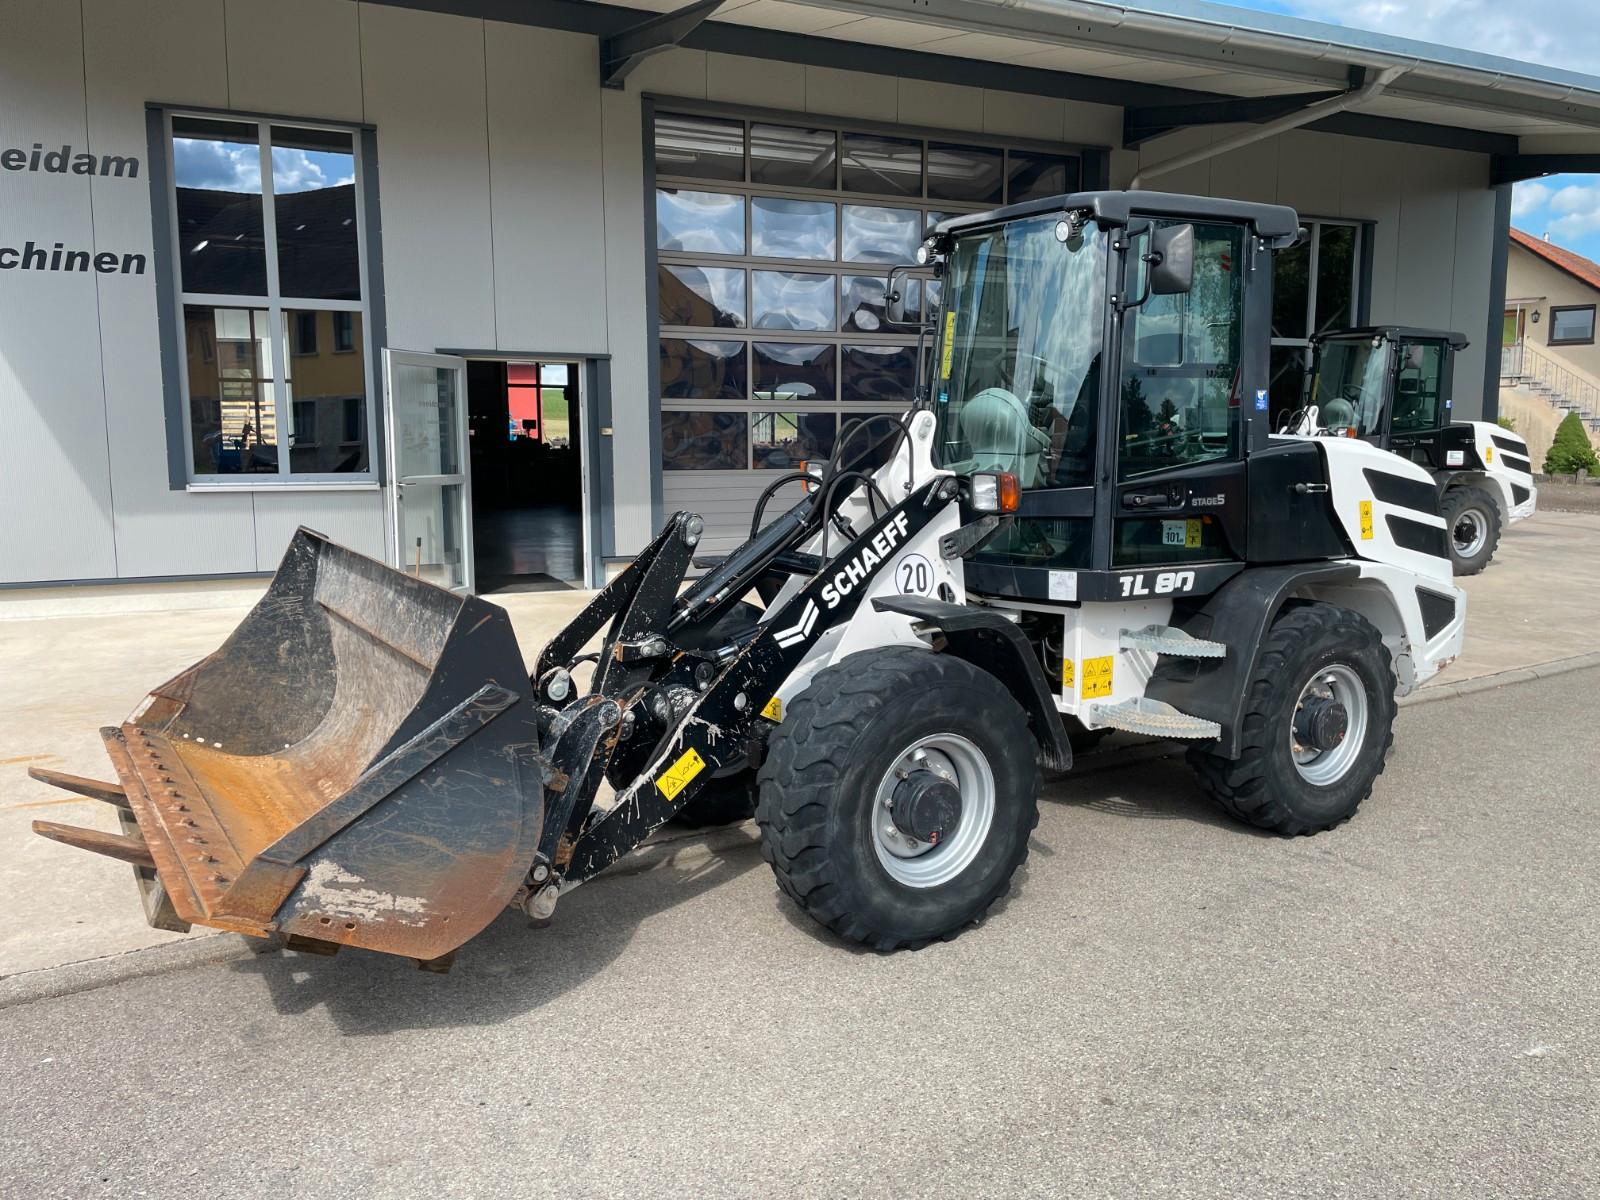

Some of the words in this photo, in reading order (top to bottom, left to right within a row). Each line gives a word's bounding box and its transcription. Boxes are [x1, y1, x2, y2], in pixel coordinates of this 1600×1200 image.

[0, 143, 140, 178] eidam
[0, 241, 147, 275] chinen
[821, 510, 909, 609] SCHAEFF
[902, 562, 927, 594] 20
